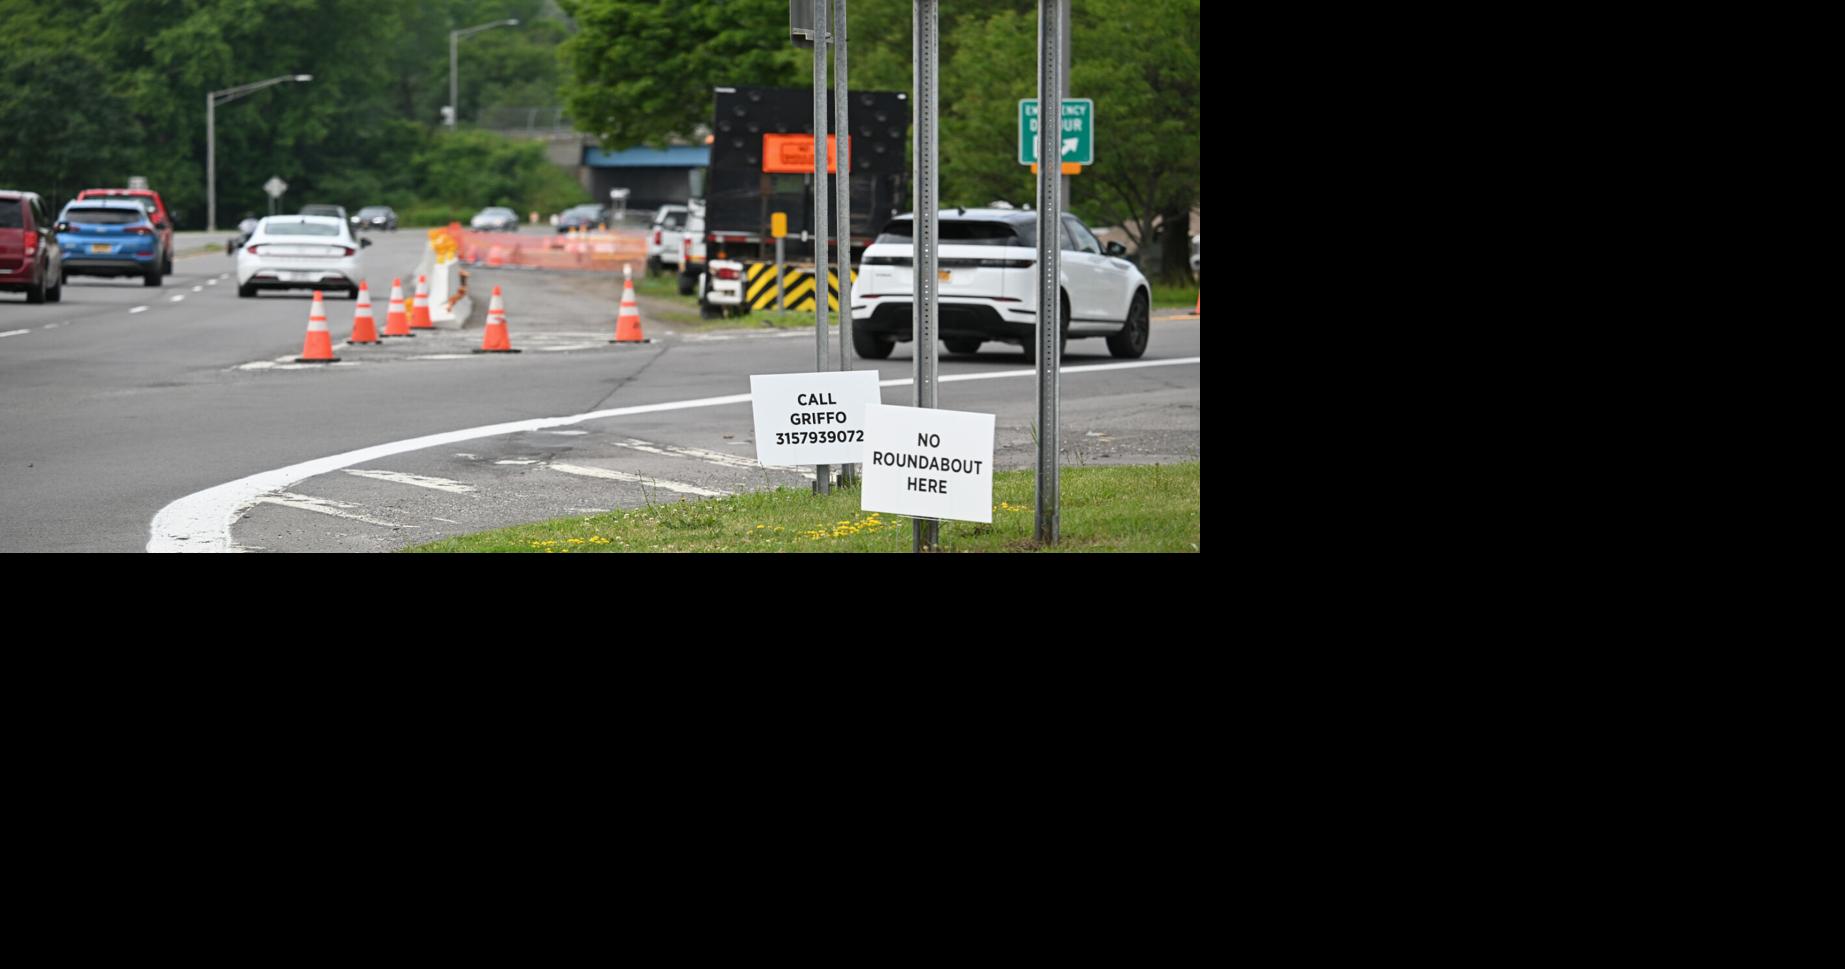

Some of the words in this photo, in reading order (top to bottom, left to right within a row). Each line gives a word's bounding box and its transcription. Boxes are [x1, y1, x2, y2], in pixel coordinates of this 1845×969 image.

[797, 392, 837, 407] CALL
[790, 411, 847, 426] GRIFFO
[775, 429, 864, 446] 3157939072
[917, 432, 940, 448] NO
[873, 450, 983, 475] ROUNDABOUT
[907, 476, 948, 494] HERE
